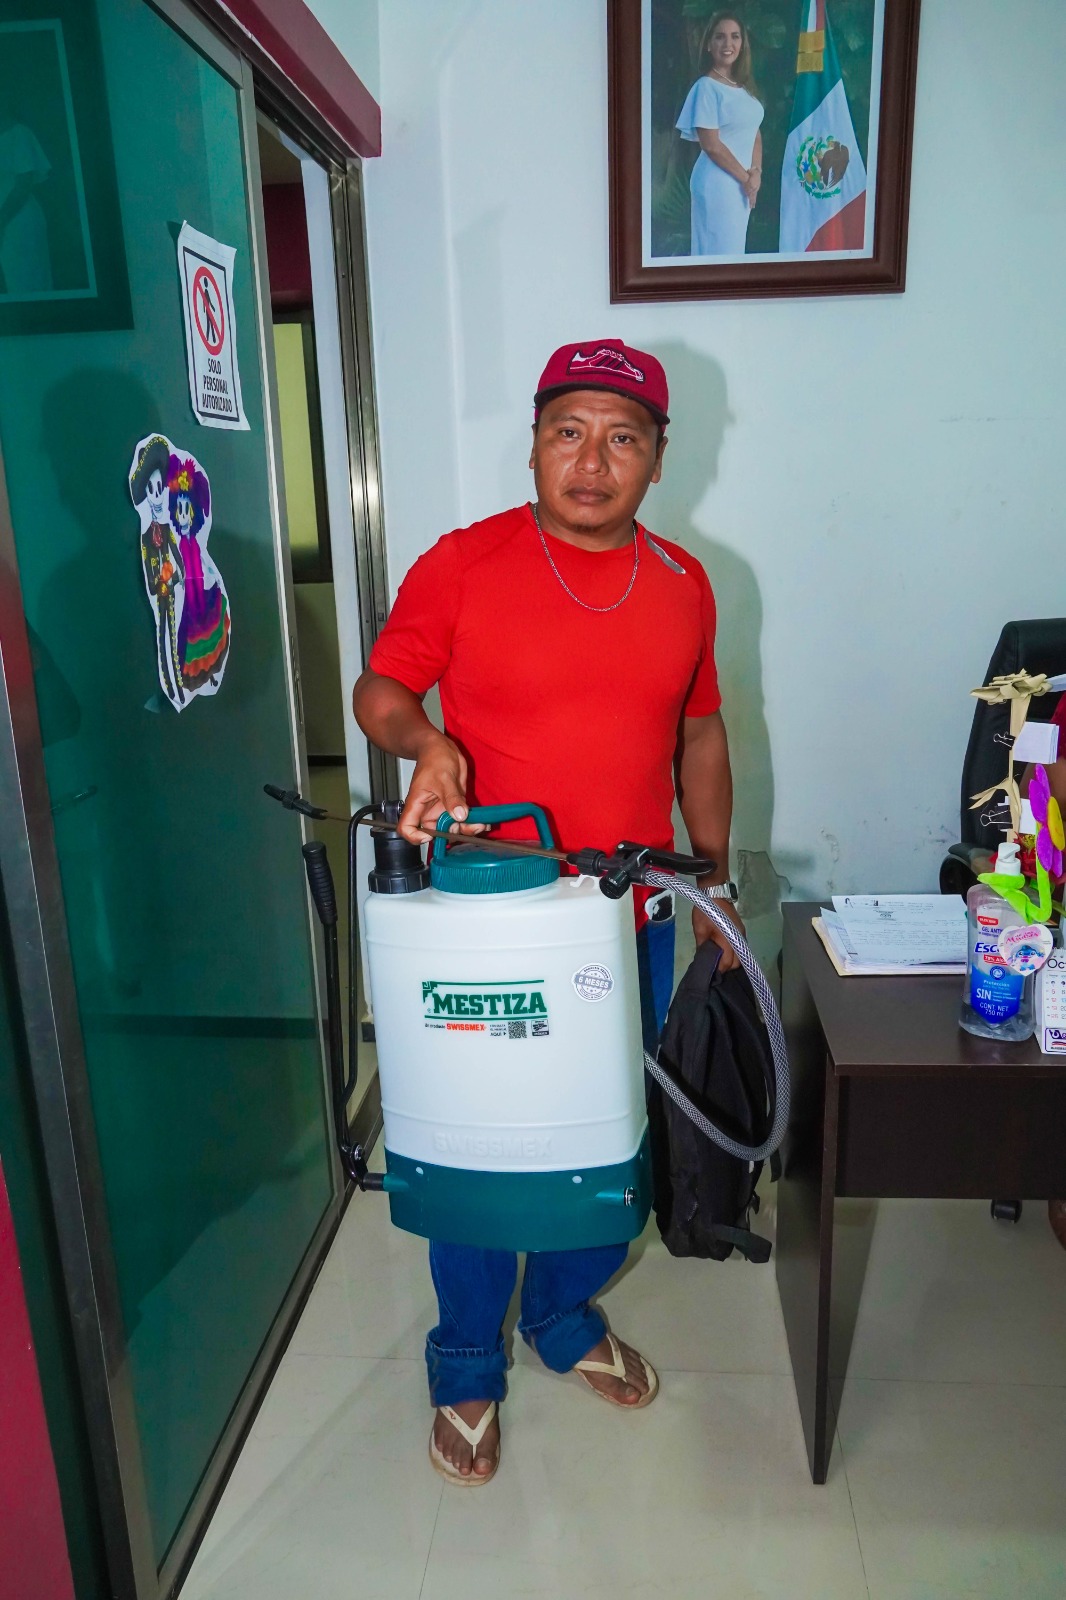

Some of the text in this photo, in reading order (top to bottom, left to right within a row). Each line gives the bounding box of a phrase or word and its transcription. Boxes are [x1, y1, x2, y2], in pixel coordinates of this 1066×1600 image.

[208, 358, 221, 374] SOLO
[203, 375, 228, 394] PERSONAL
[202, 393, 232, 412] AUTORIZADO
[974, 942, 999, 953] Esc
[585, 977, 609, 989] MESES
[976, 988, 992, 1000] SIN
[432, 992, 547, 1015] MESTIZA
[985, 1008, 996, 1016] 750
[446, 1023, 485, 1032] SWISSMEX
